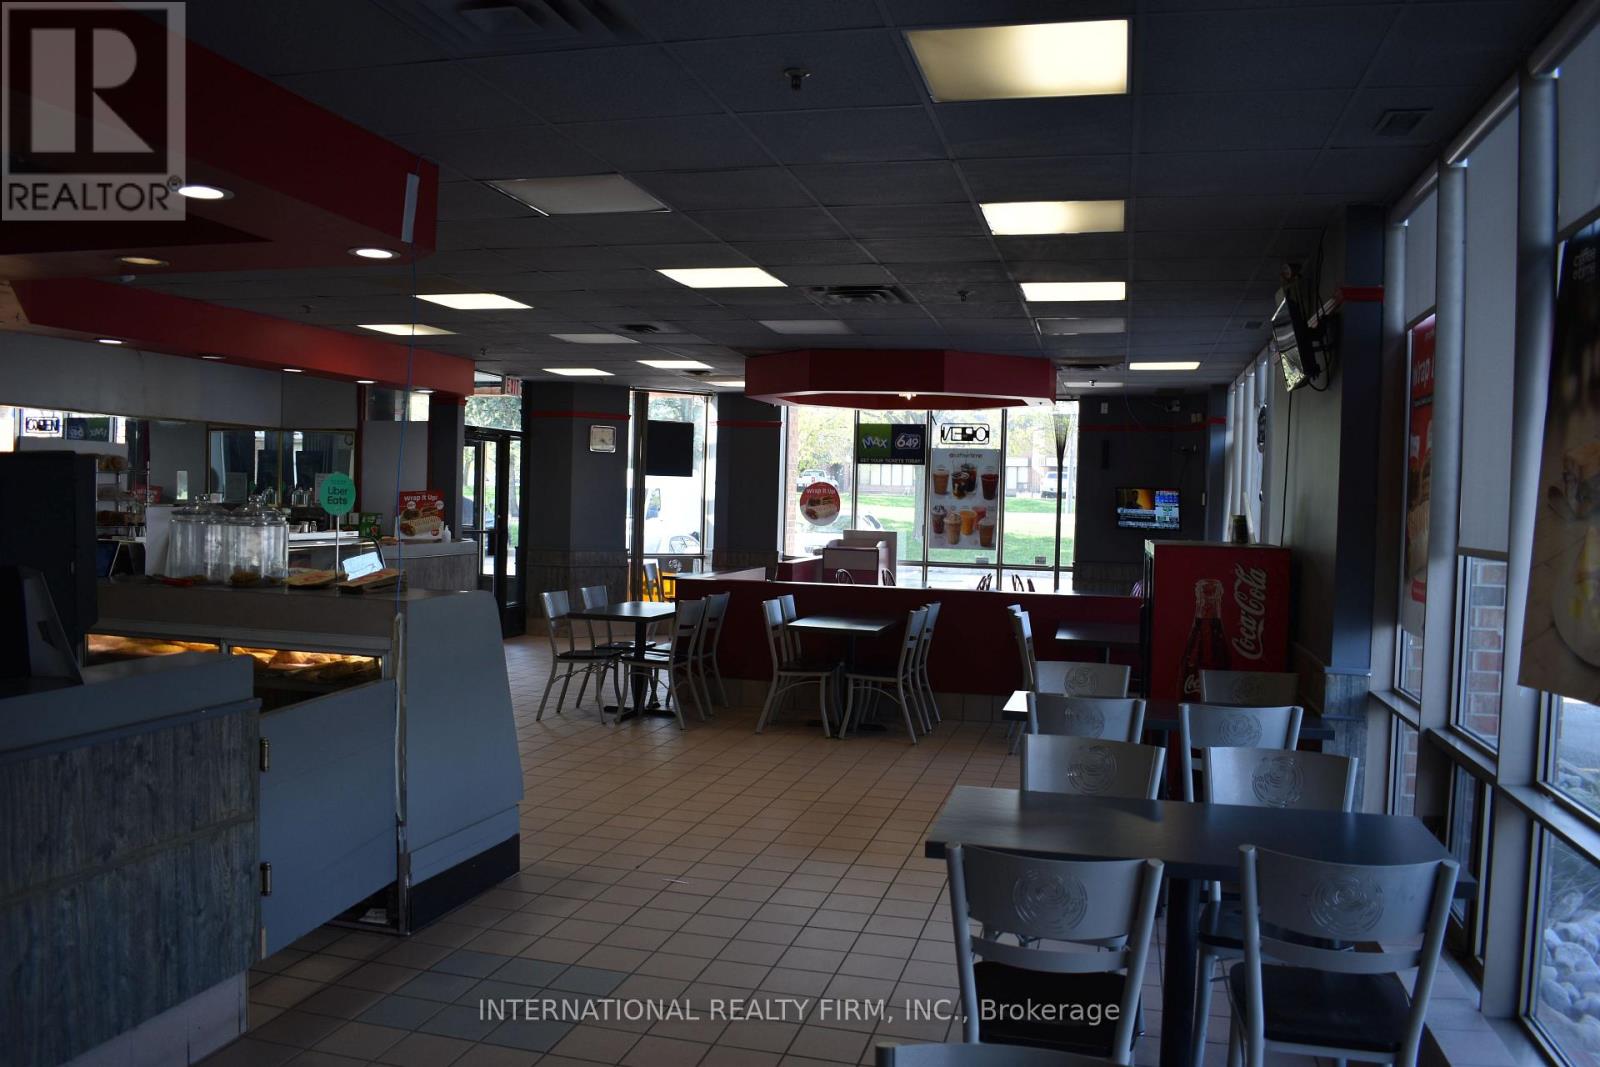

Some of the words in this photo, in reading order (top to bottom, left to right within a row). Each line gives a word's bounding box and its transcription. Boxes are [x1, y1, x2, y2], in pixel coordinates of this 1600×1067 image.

[507, 377, 519, 394] EXIT
[862, 436, 887, 449] MAX
[327, 486, 348, 495] Uber
[327, 496, 348, 505] Eats
